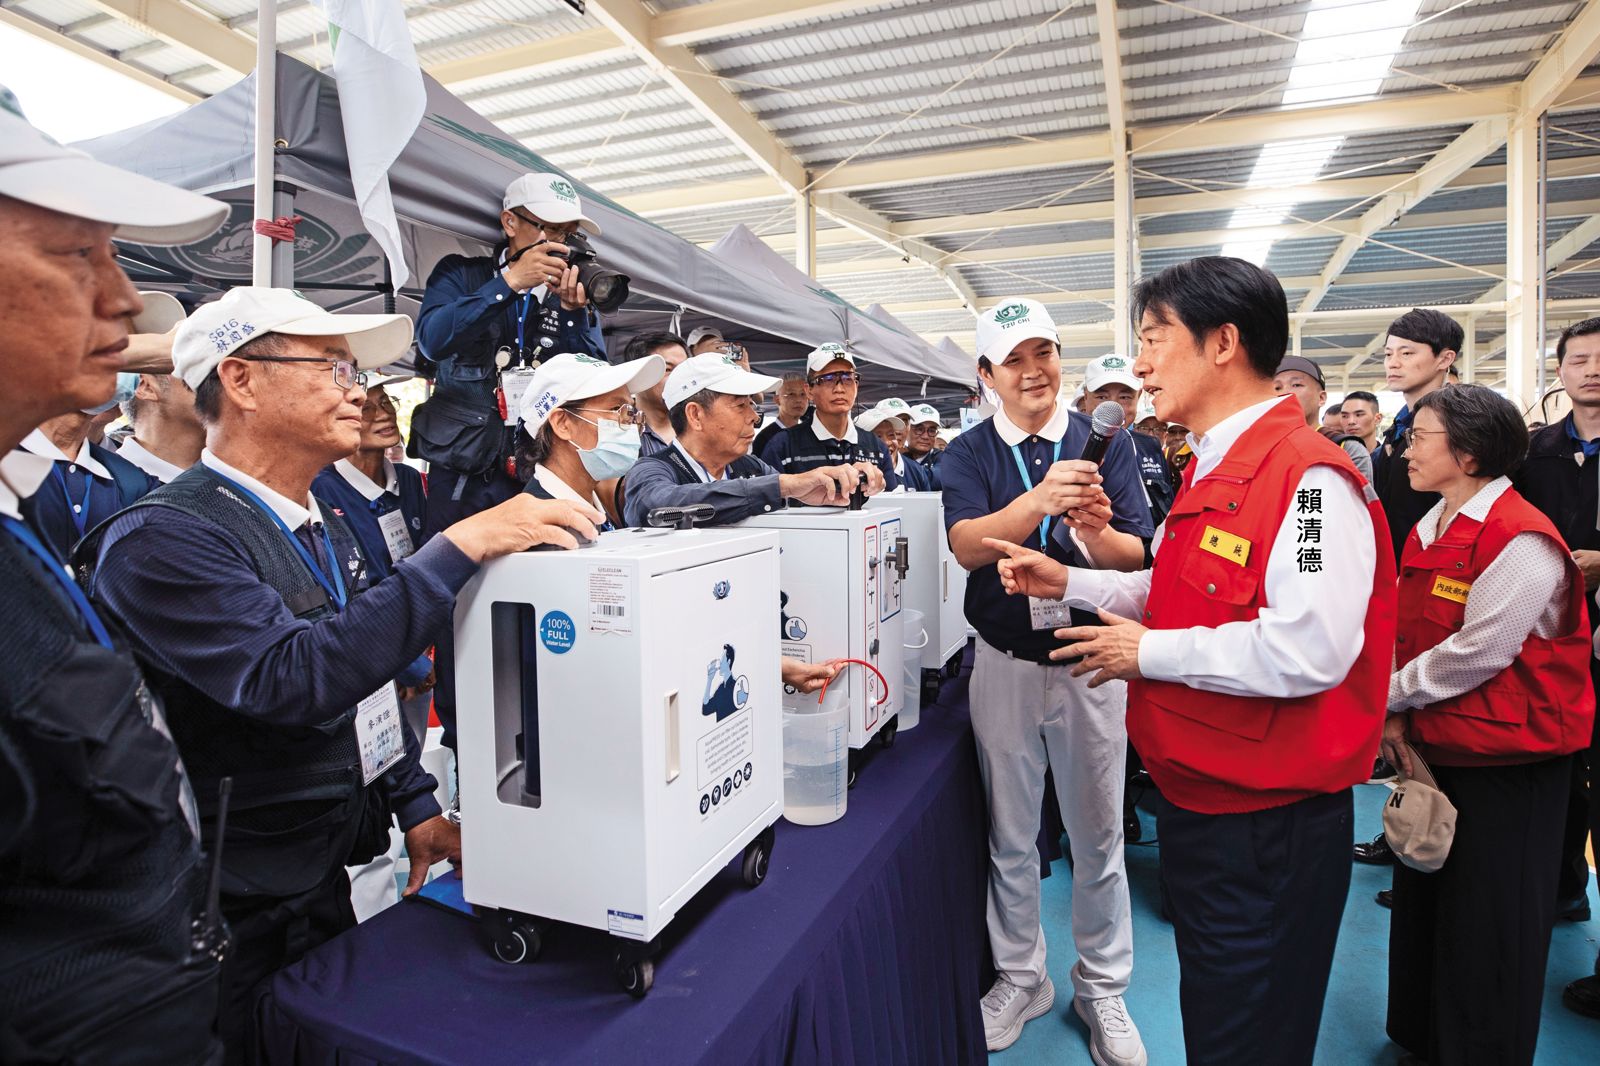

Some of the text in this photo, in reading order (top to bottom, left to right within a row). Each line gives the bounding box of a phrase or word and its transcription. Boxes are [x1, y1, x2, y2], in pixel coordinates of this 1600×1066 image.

[1001, 317, 1031, 330] TZU CHI
[209, 318, 239, 343] S616
[546, 618, 571, 631] 100%
[547, 630, 569, 641] FULL
[545, 639, 559, 647] Water
[1390, 792, 1405, 809] N
